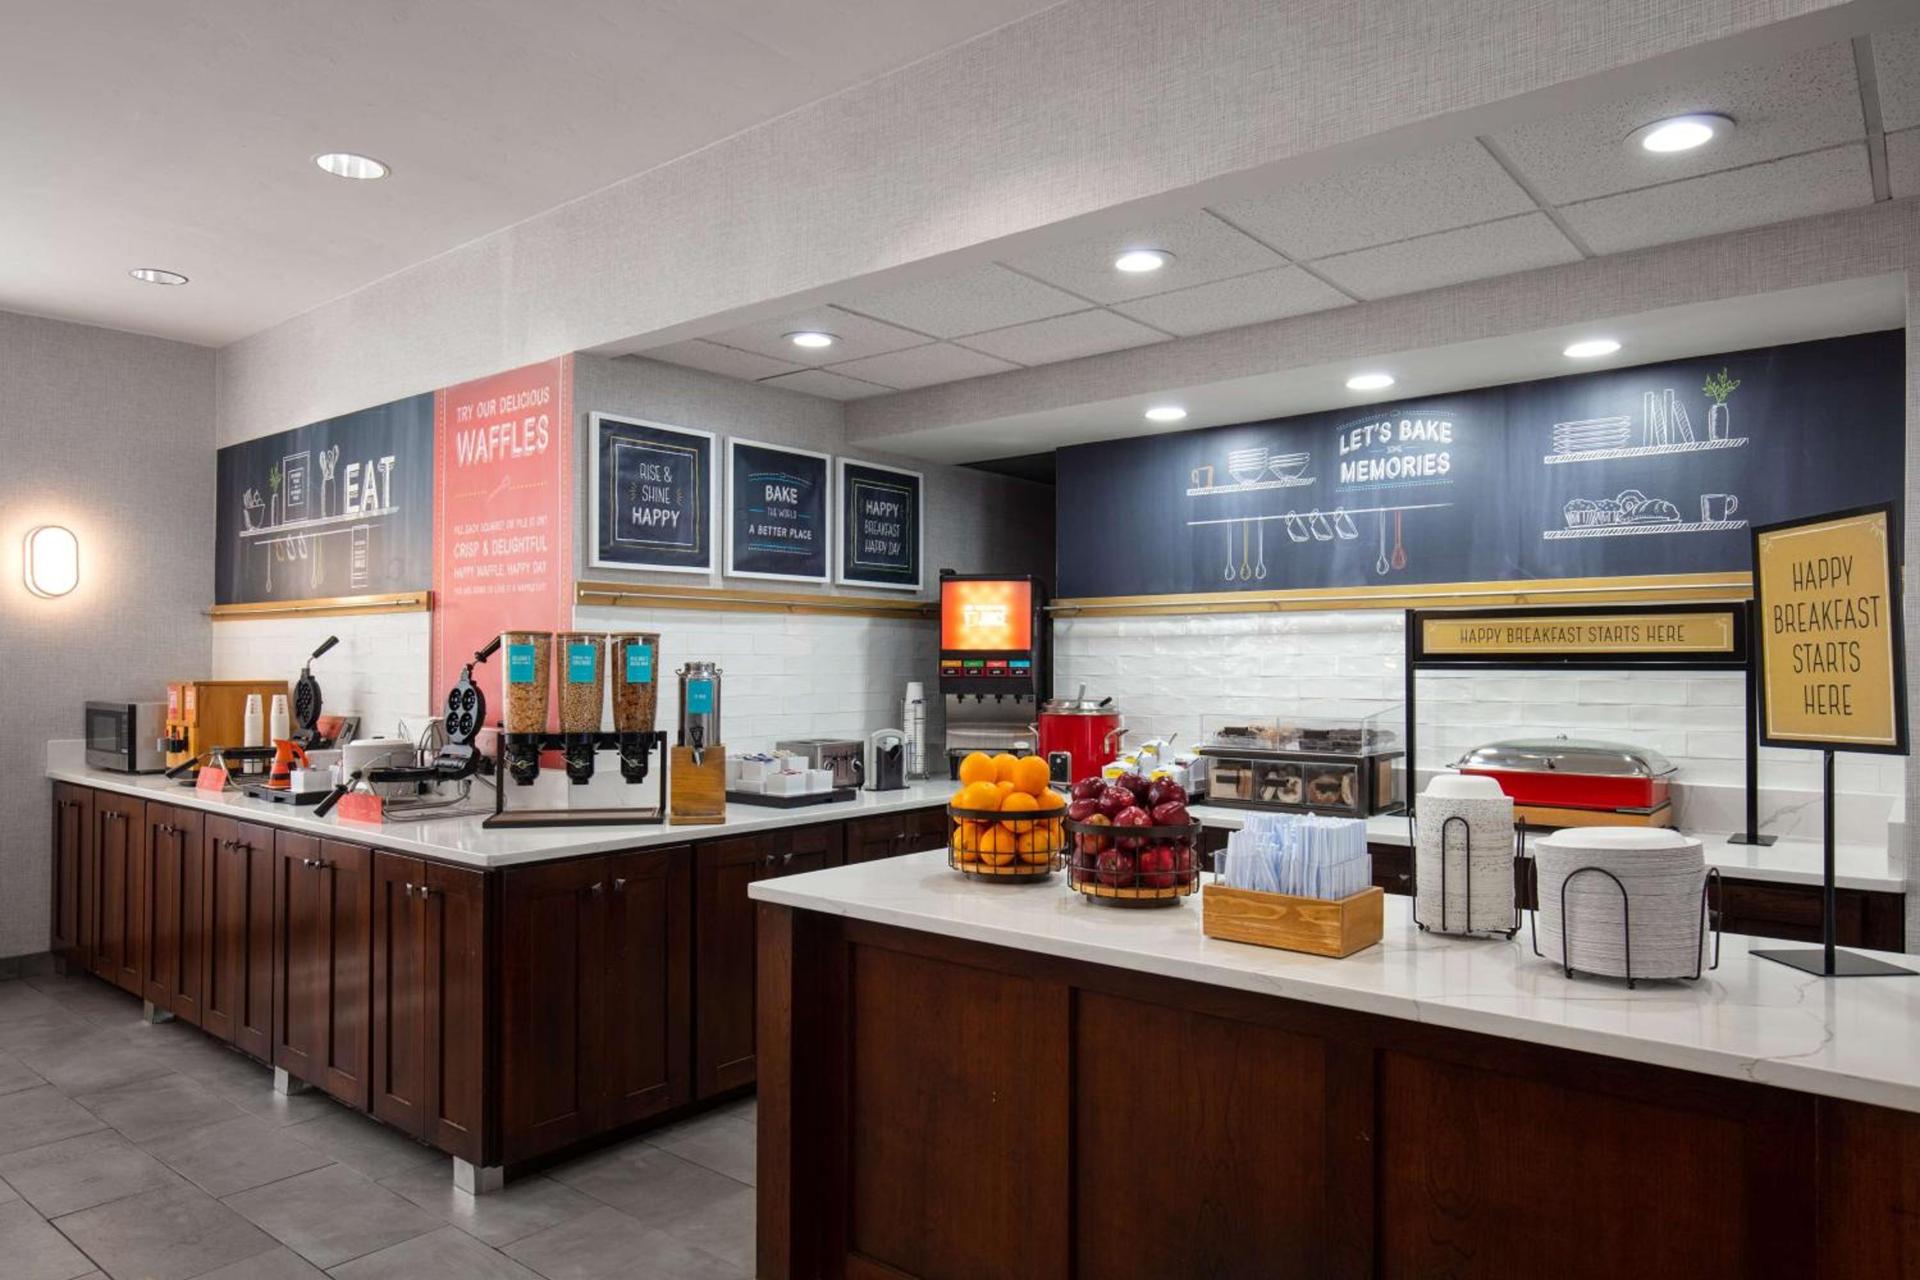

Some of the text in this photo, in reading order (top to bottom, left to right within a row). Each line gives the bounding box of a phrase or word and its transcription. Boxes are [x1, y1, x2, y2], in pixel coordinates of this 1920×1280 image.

[456, 386, 550, 424] TRY OUR DELICIOUS
[456, 414, 550, 468] WAFFLES
[1339, 419, 1453, 455] LET'S BAKE
[640, 462, 673, 483] RISE &
[1340, 452, 1451, 484] MEMORIES
[344, 456, 395, 514] EAT
[642, 484, 671, 504] SHINE
[765, 484, 798, 505] BAKE
[632, 506, 680, 528] HAPPY
[866, 500, 899, 517] HAPPY
[491, 534, 548, 556] DELIGHTFUL
[748, 524, 813, 540] A BETTER PLACE
[1792, 555, 1853, 592] HAPPY
[1774, 596, 1880, 634] BREAKFAST
[1460, 624, 1685, 644] HAPPY BREAKFAST STARTS HERE
[1793, 641, 1860, 673] STARTS
[1804, 684, 1853, 716] HERE
